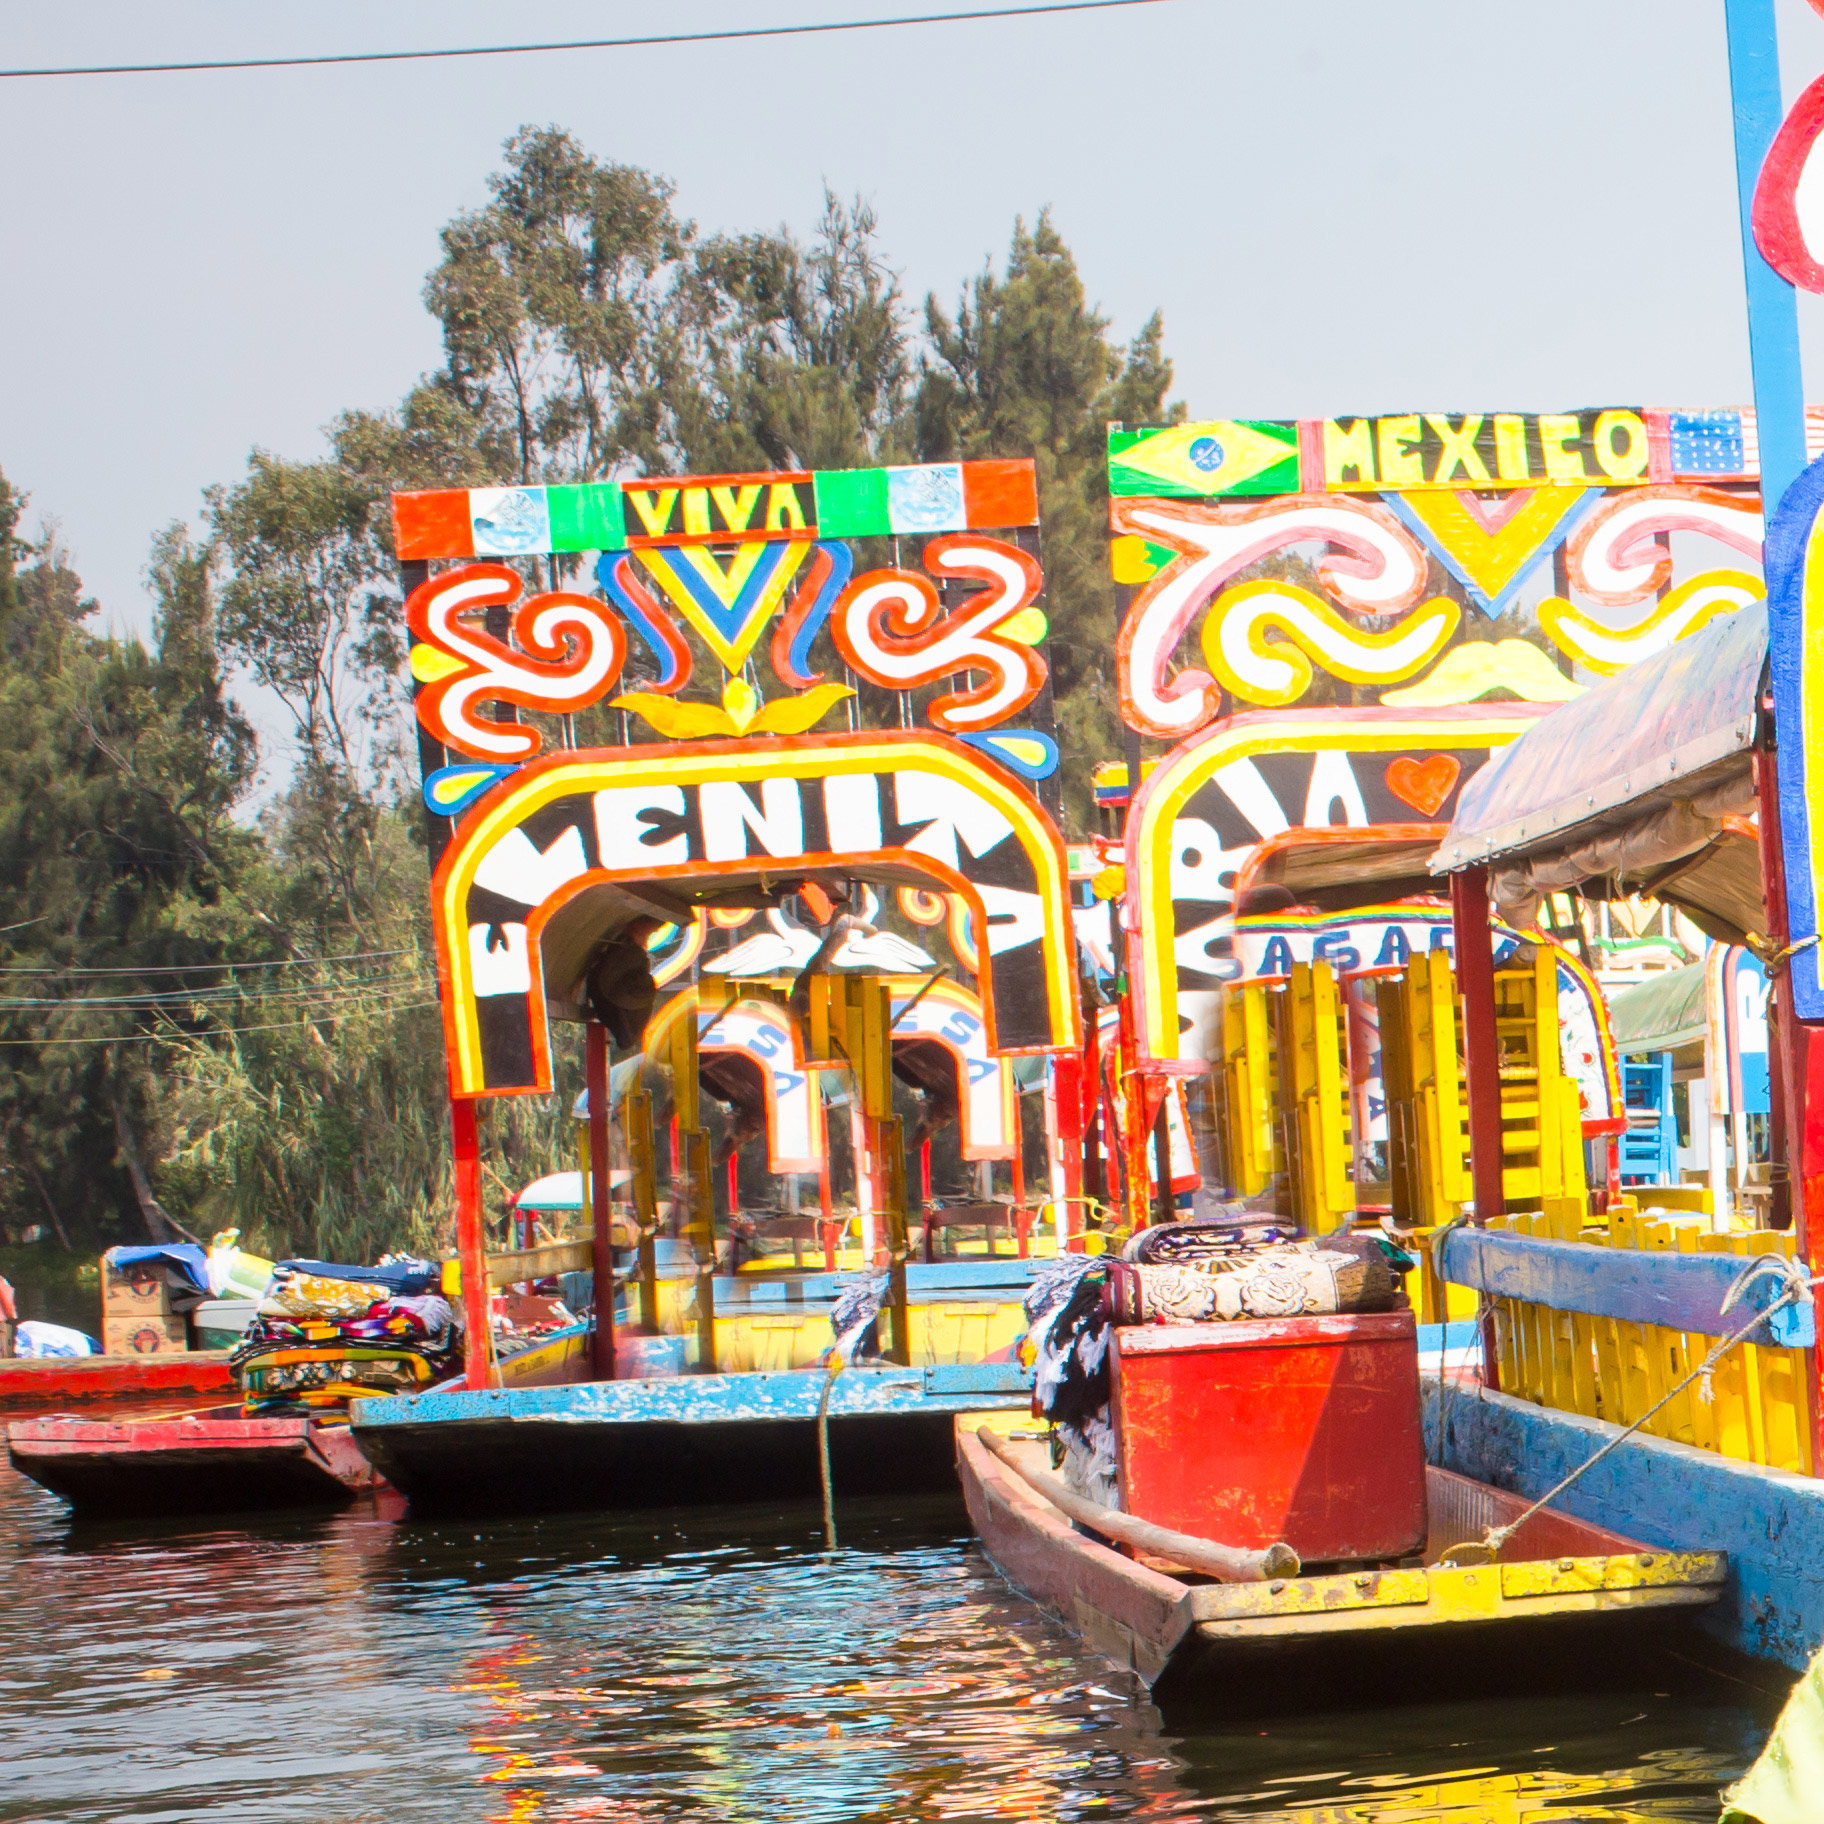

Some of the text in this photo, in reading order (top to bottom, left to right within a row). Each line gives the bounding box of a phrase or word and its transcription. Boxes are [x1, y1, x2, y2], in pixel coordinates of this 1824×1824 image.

[1324, 409, 1650, 483] MEXICO
[627, 483, 806, 537] VIVA
[468, 770, 1045, 998] ELENITA
